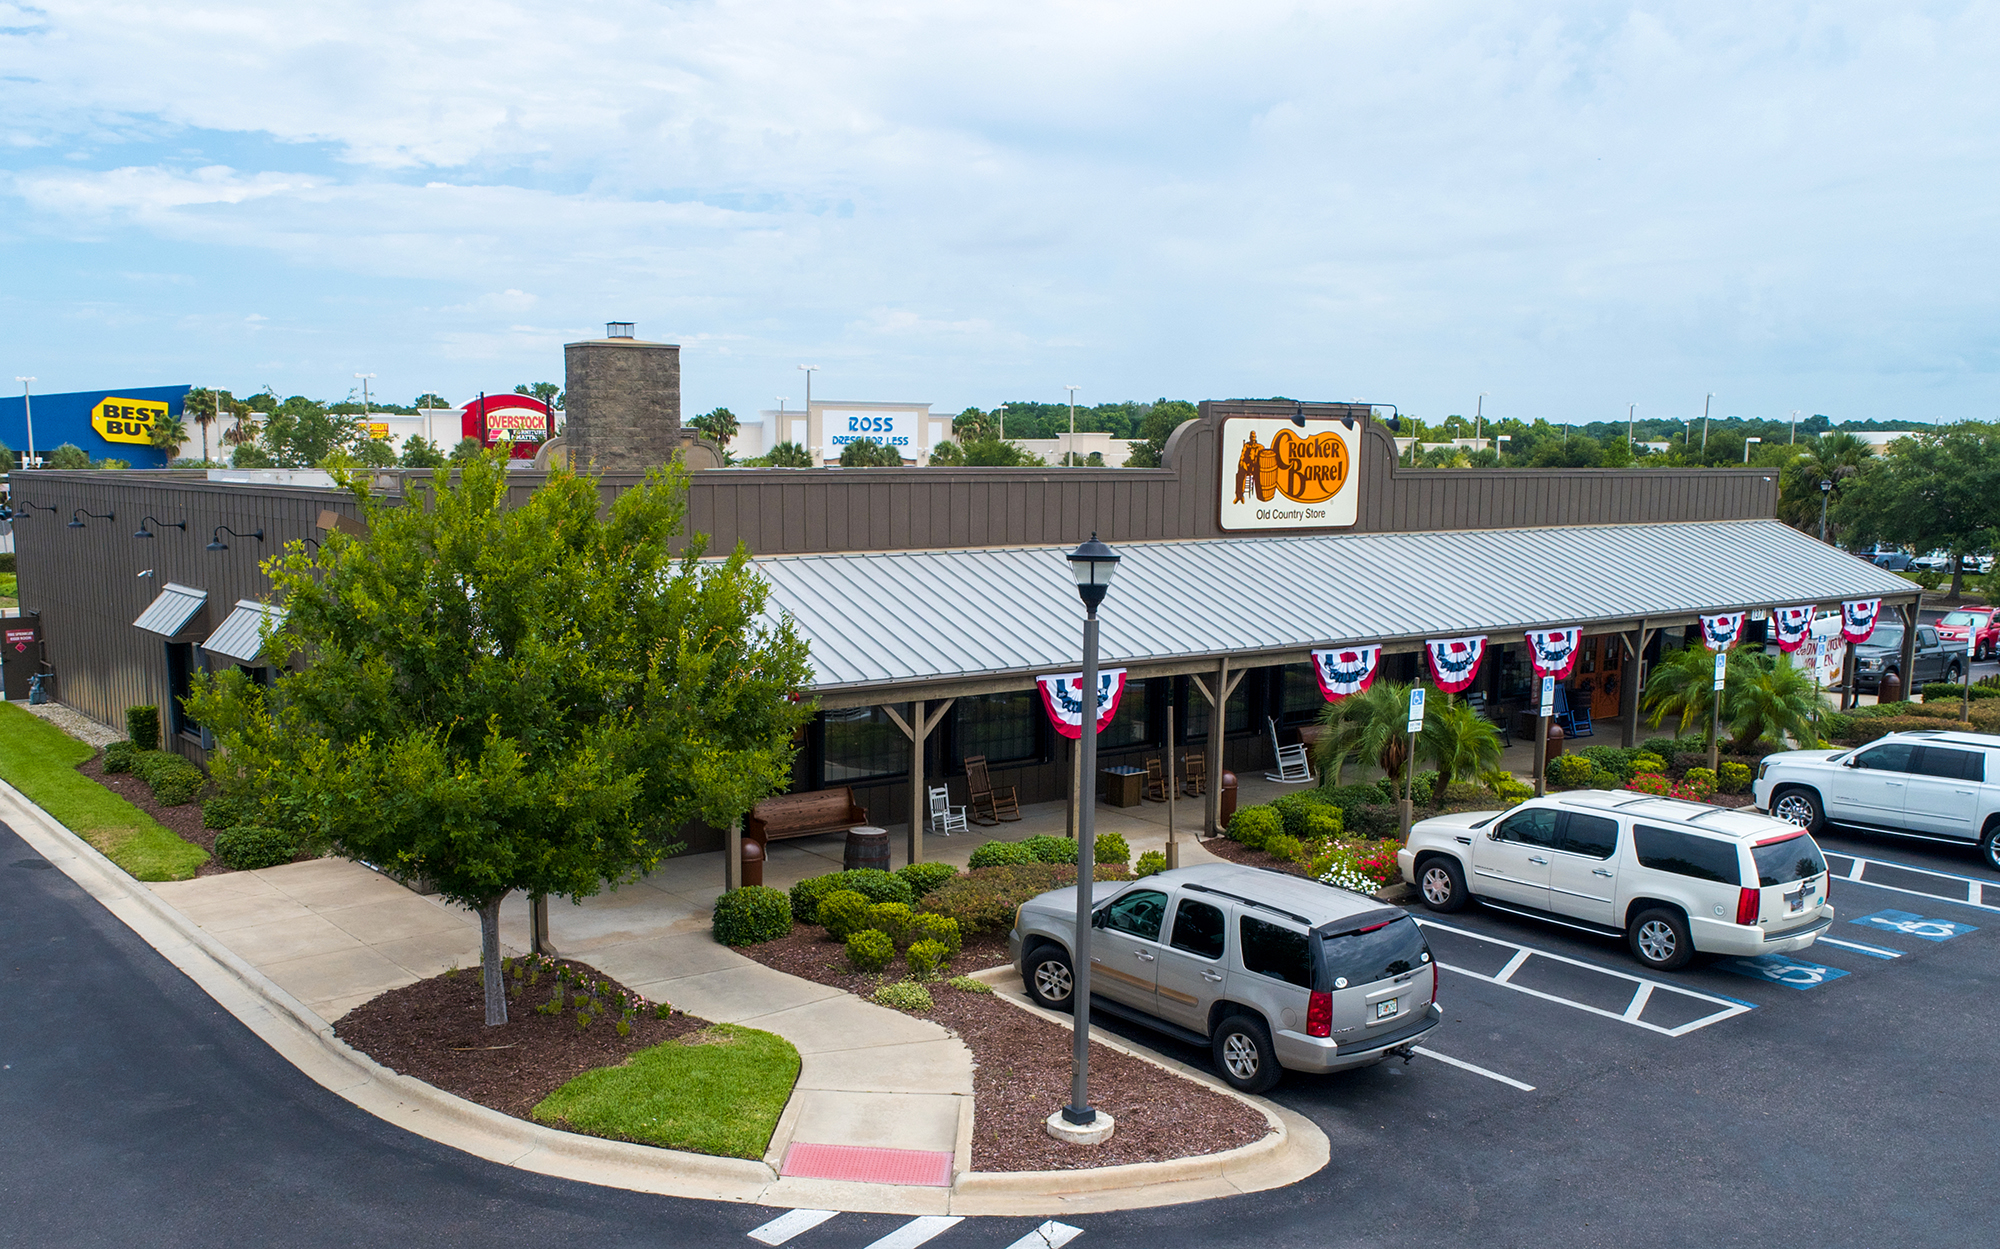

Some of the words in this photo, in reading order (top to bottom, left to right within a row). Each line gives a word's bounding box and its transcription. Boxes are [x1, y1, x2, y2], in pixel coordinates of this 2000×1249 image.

[103, 404, 165, 422] BEST
[488, 415, 546, 429] OVERSTOCK
[848, 416, 894, 432] ROSS
[886, 436, 909, 446] LESS
[1274, 431, 1341, 471] Cracker
[1287, 457, 1343, 499] Barrel
[1256, 508, 1271, 520] Old
[1272, 508, 1304, 521] Country
[1305, 508, 1326, 519] Store
